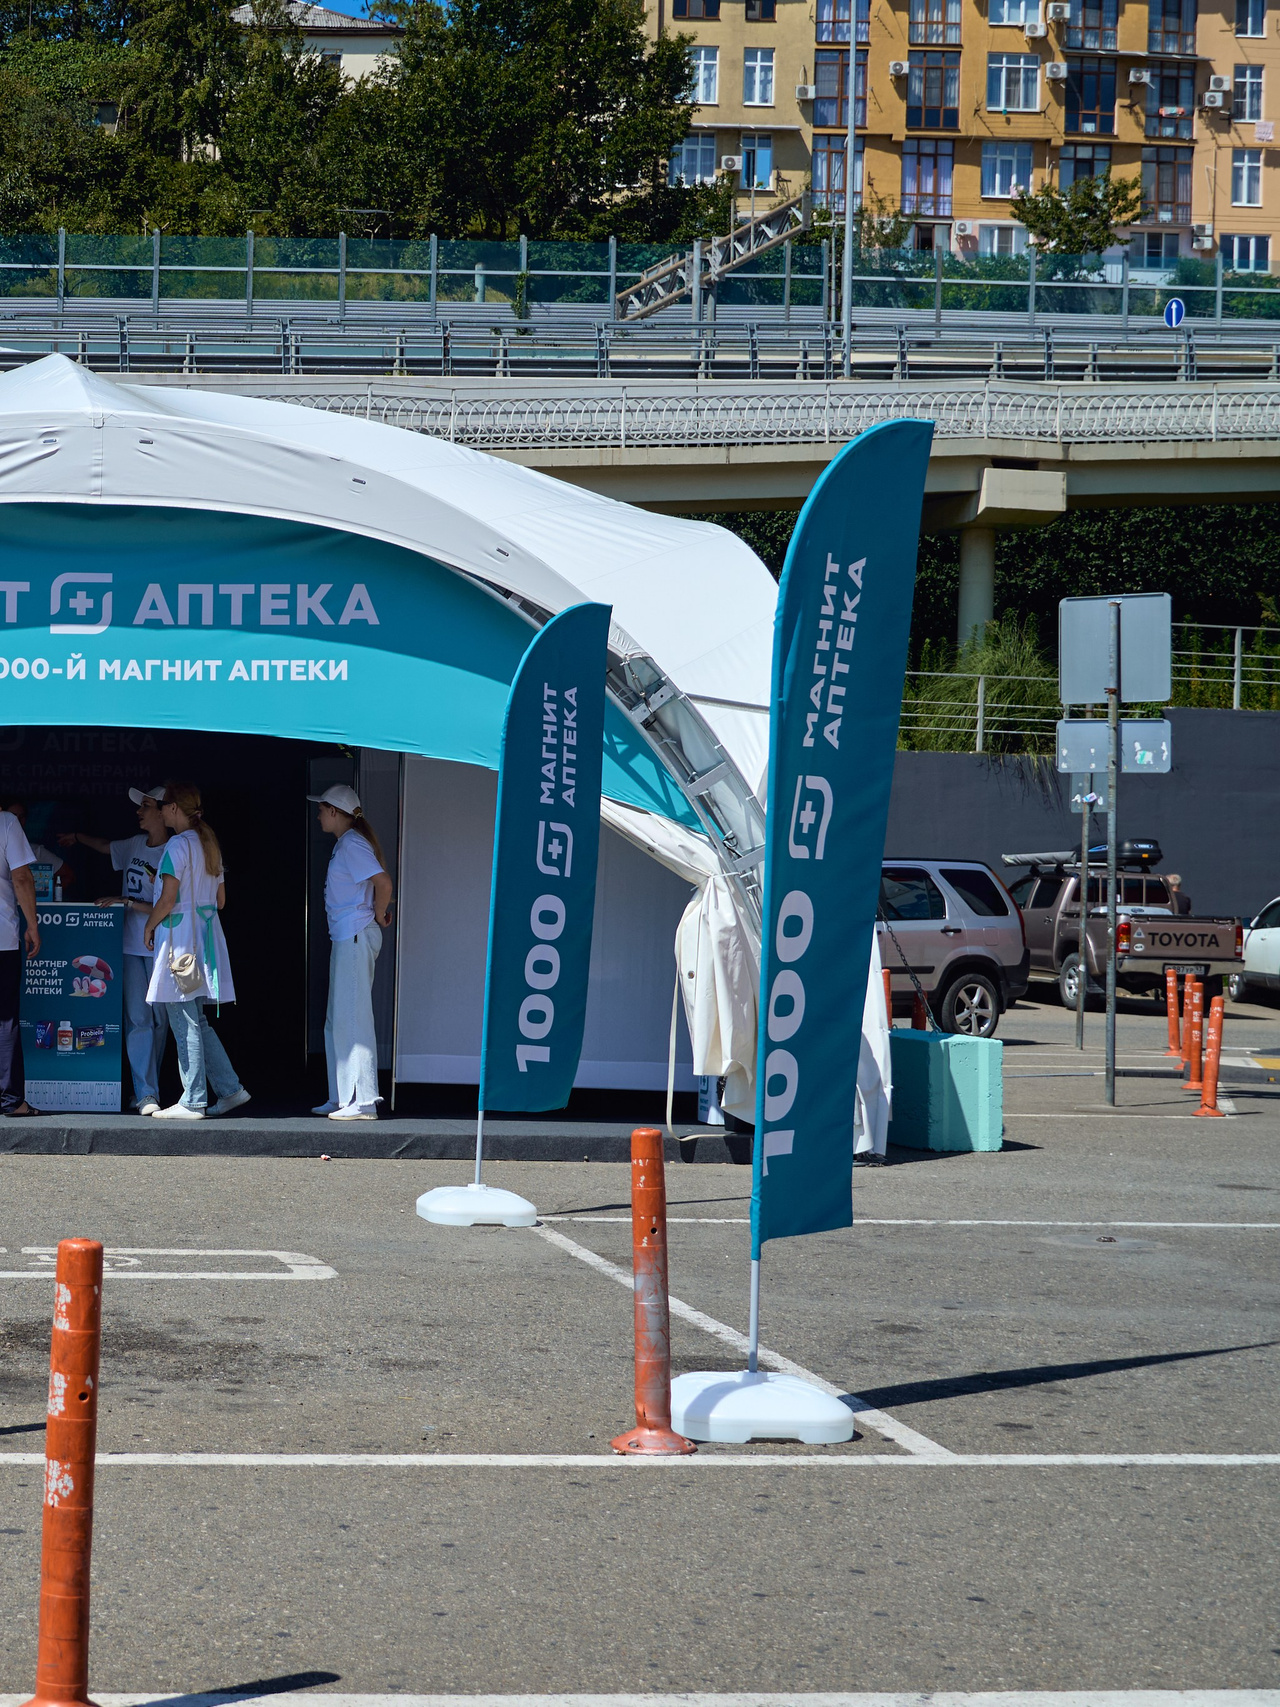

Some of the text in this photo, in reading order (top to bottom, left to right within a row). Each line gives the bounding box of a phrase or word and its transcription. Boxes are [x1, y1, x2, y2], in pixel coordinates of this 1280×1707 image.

[133, 583, 380, 625] АПТЕКА
[99, 659, 223, 681] МАГНИТ
[227, 659, 349, 681] АПТЕКИ
[802, 552, 839, 748] МАГНИТ
[823, 556, 867, 750] АПТЕКА
[539, 682, 557, 805] МАГНИТ
[562, 687, 577, 808] АПТЕКА
[1148, 932, 1220, 948] TOYOTA
[25, 960, 68, 968] ПАРТНЕР
[25, 967, 58, 976] 1000-Й
[25, 978, 64, 986] МАГНИТ
[515, 894, 566, 1072] 1000
[25, 987, 62, 995] АПТЕКИ
[763, 889, 814, 1177] 1000
